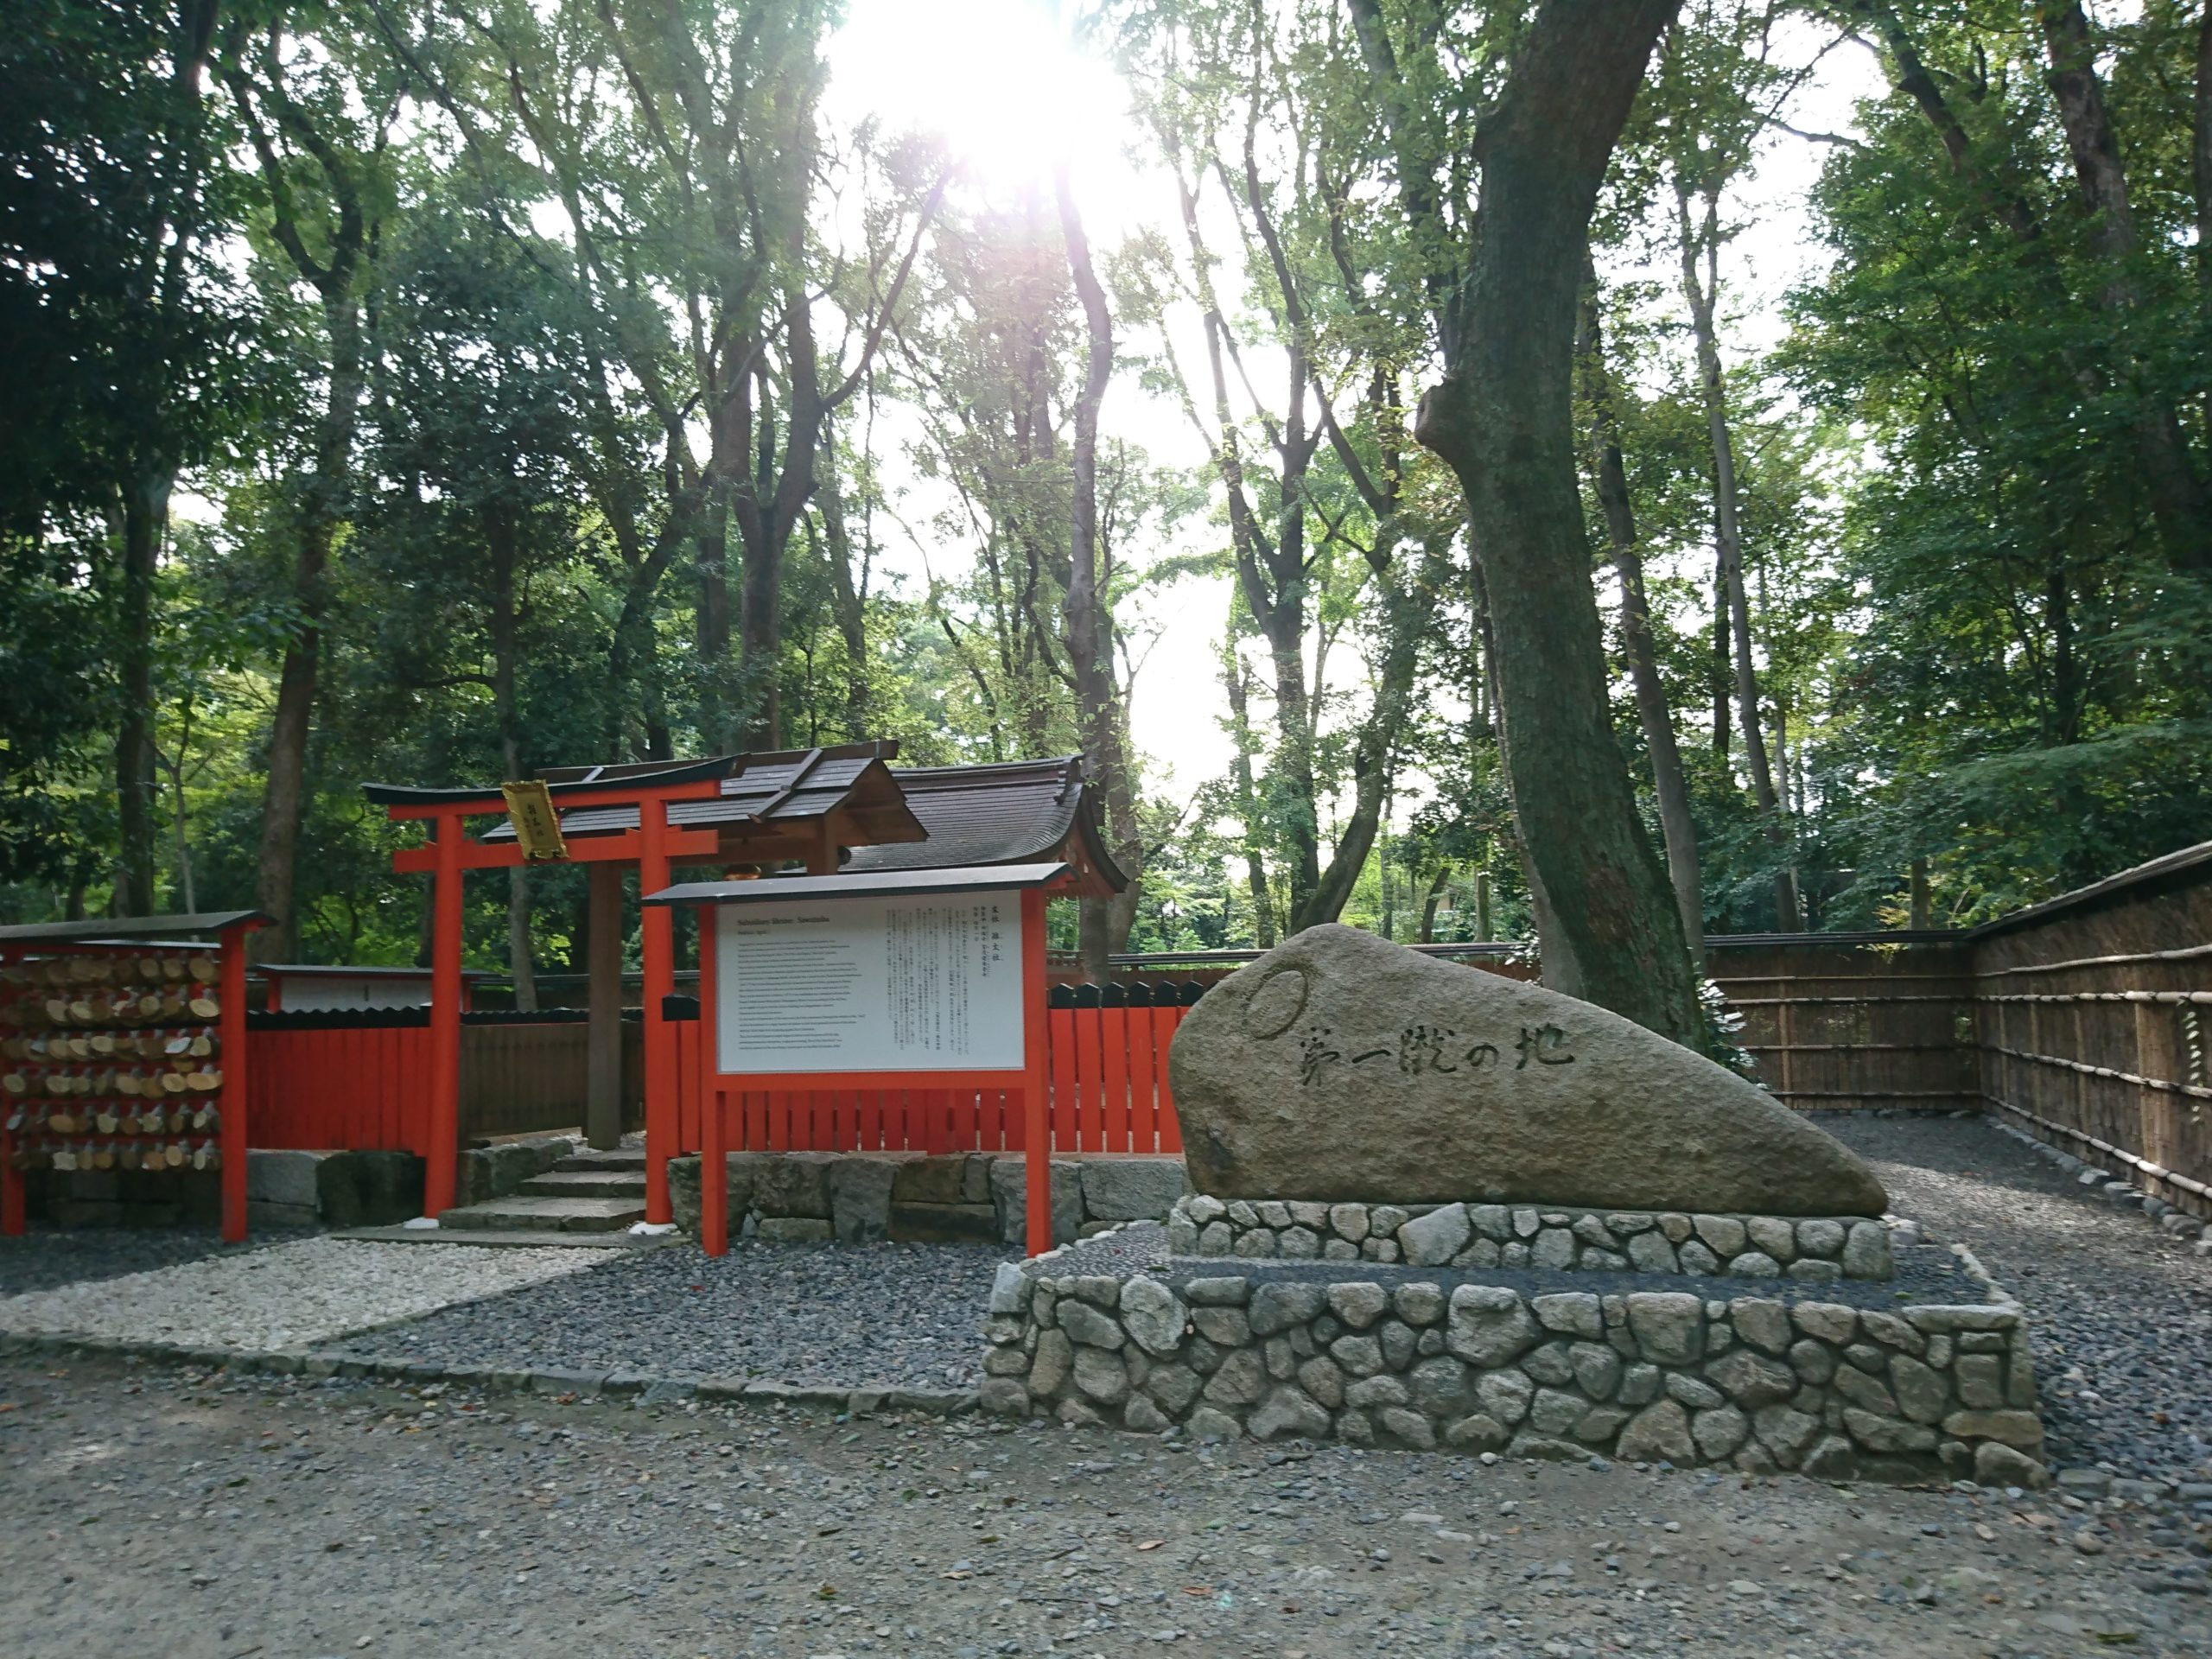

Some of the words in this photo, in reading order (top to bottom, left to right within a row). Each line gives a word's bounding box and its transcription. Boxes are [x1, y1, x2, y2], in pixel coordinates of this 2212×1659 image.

[1299, 1022, 1575, 1087] 第一蹴の地
